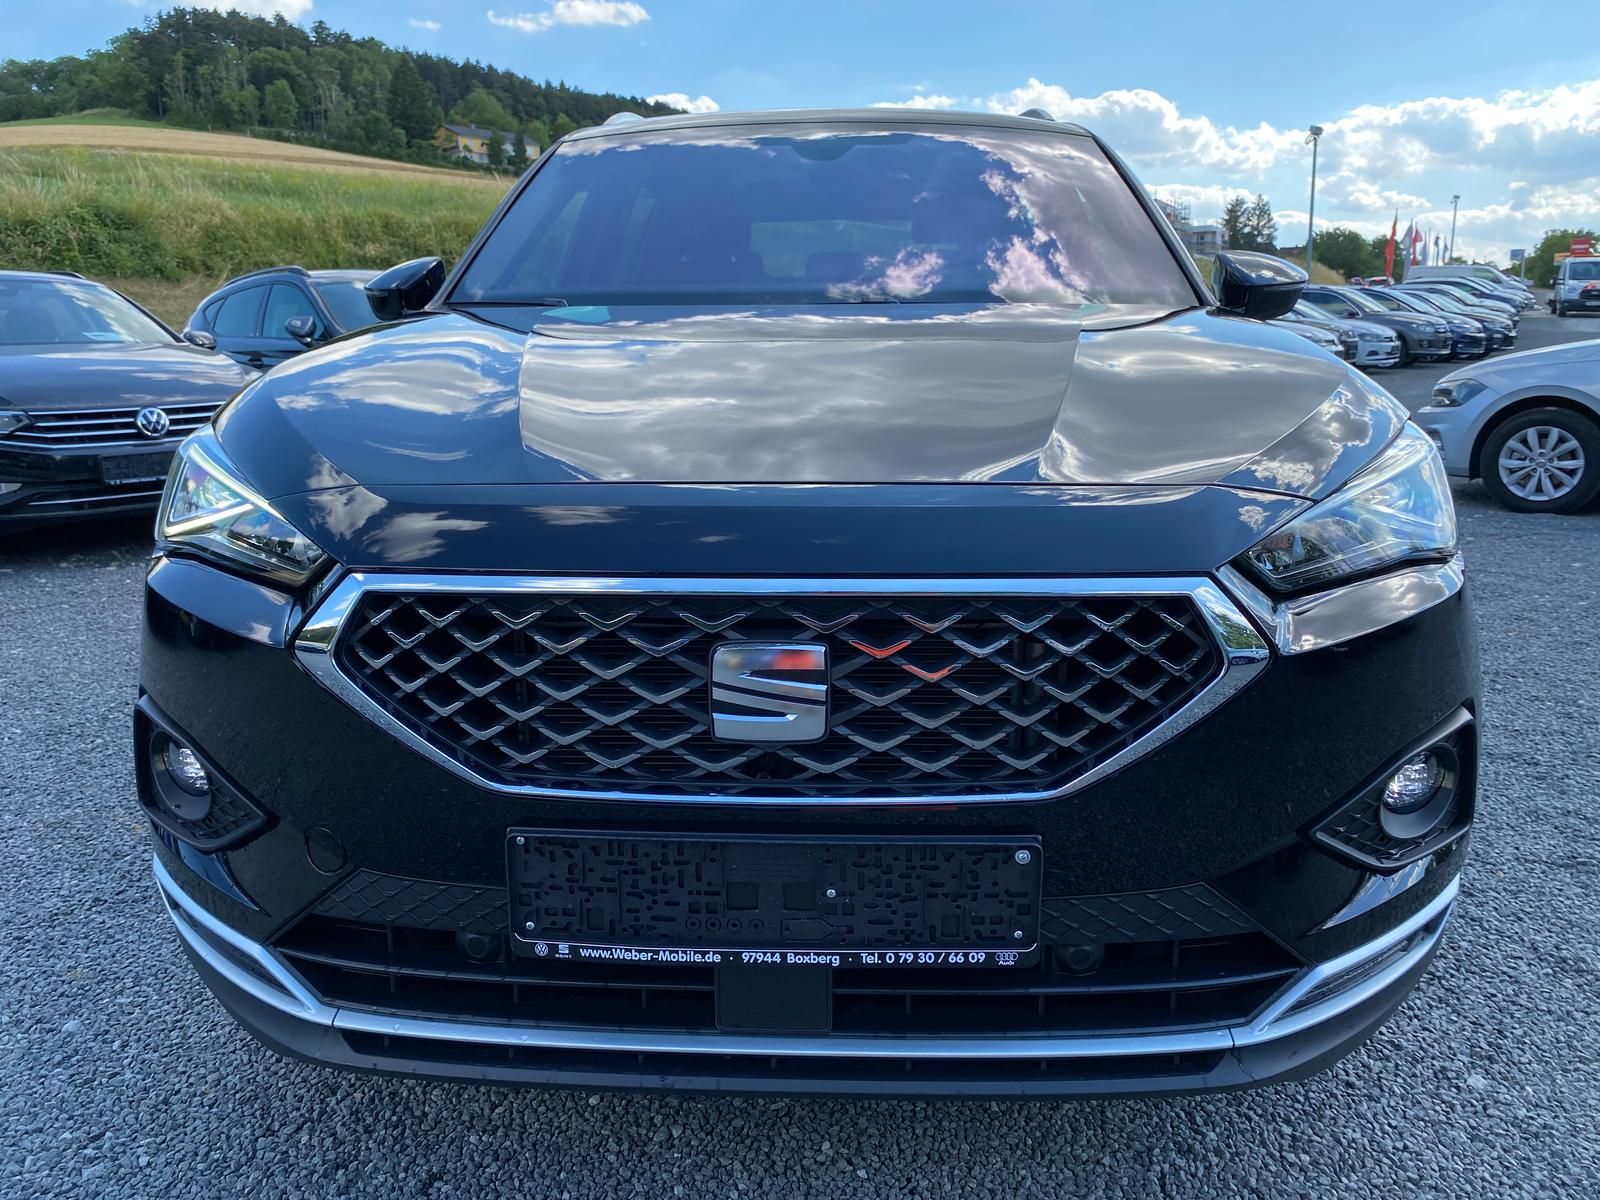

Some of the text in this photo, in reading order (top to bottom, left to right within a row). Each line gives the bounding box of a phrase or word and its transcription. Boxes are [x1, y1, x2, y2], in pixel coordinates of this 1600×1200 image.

[579, 949, 721, 963] www.Weber-Mobile.de
[741, 952, 782, 963] 97944
[787, 952, 840, 966] Boxberg
[860, 952, 882, 963] Tel.
[885, 952, 895, 963] 0
[898, 952, 914, 963] 79
[917, 952, 935, 963] 30
[948, 952, 966, 963] 66
[968, 952, 986, 963] 09
